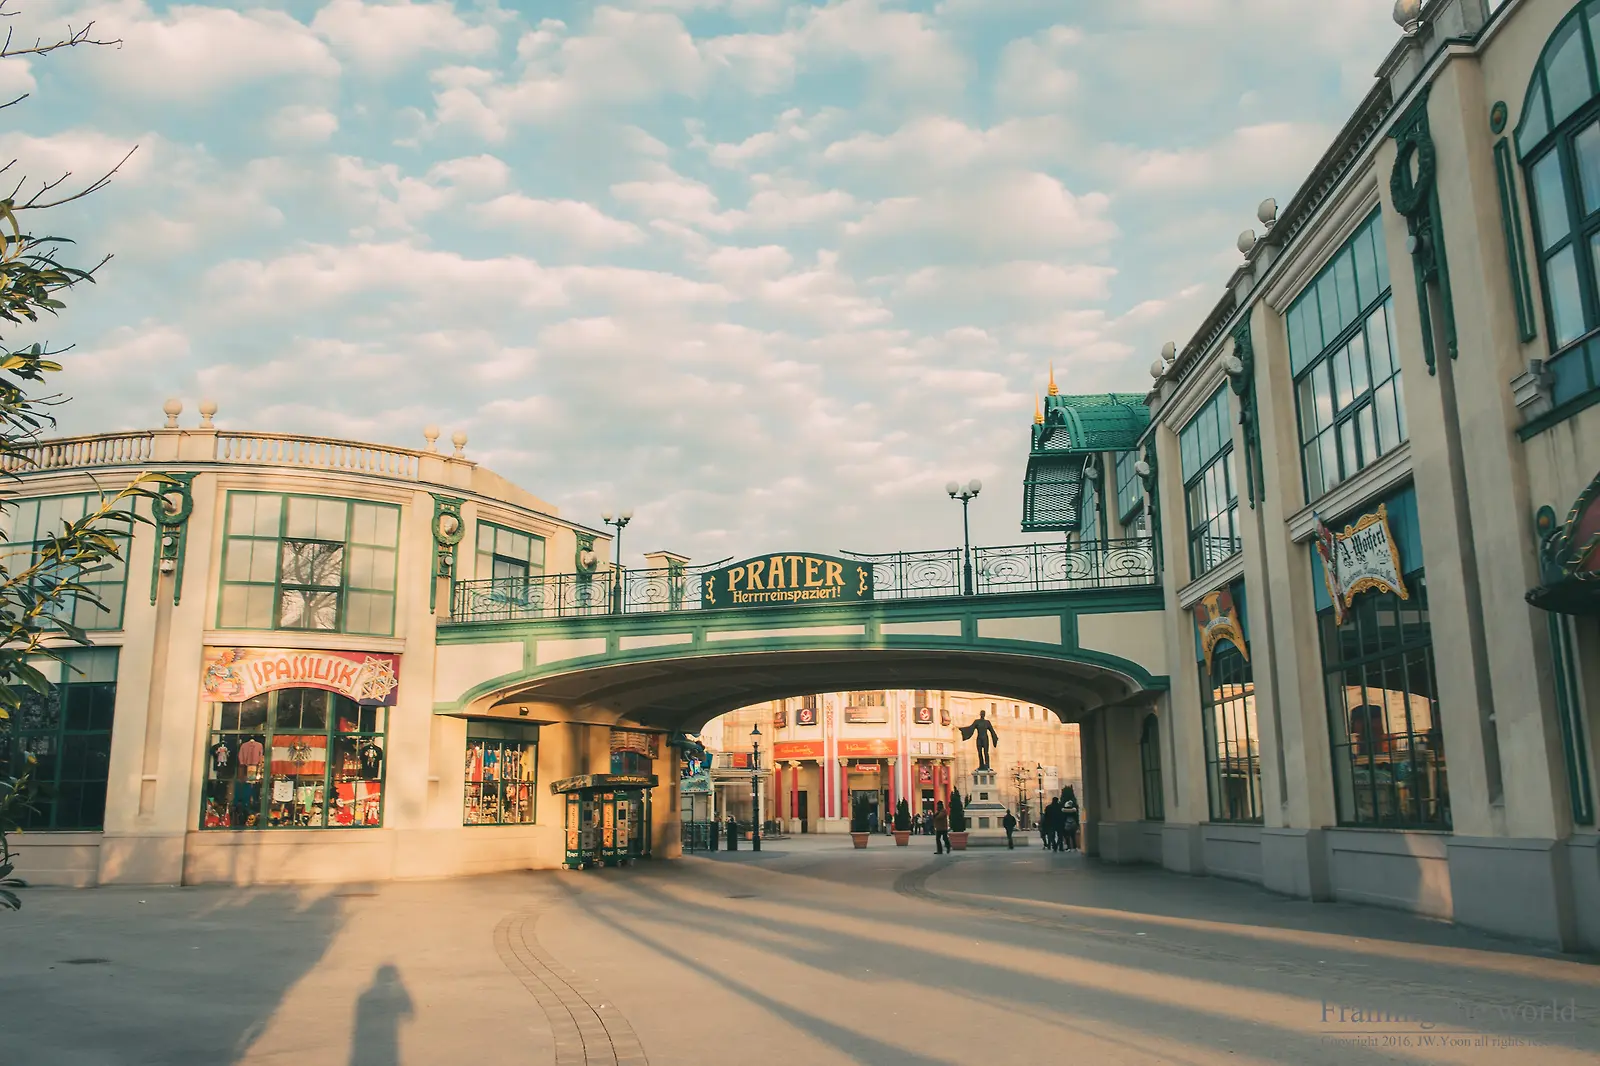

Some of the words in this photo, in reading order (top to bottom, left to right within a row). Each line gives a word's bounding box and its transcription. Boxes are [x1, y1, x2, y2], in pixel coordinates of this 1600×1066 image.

[728, 556, 845, 591] PRATER
[733, 586, 841, 603] Herrrreinspaziert!
[253, 655, 358, 687] SPASSILISK
